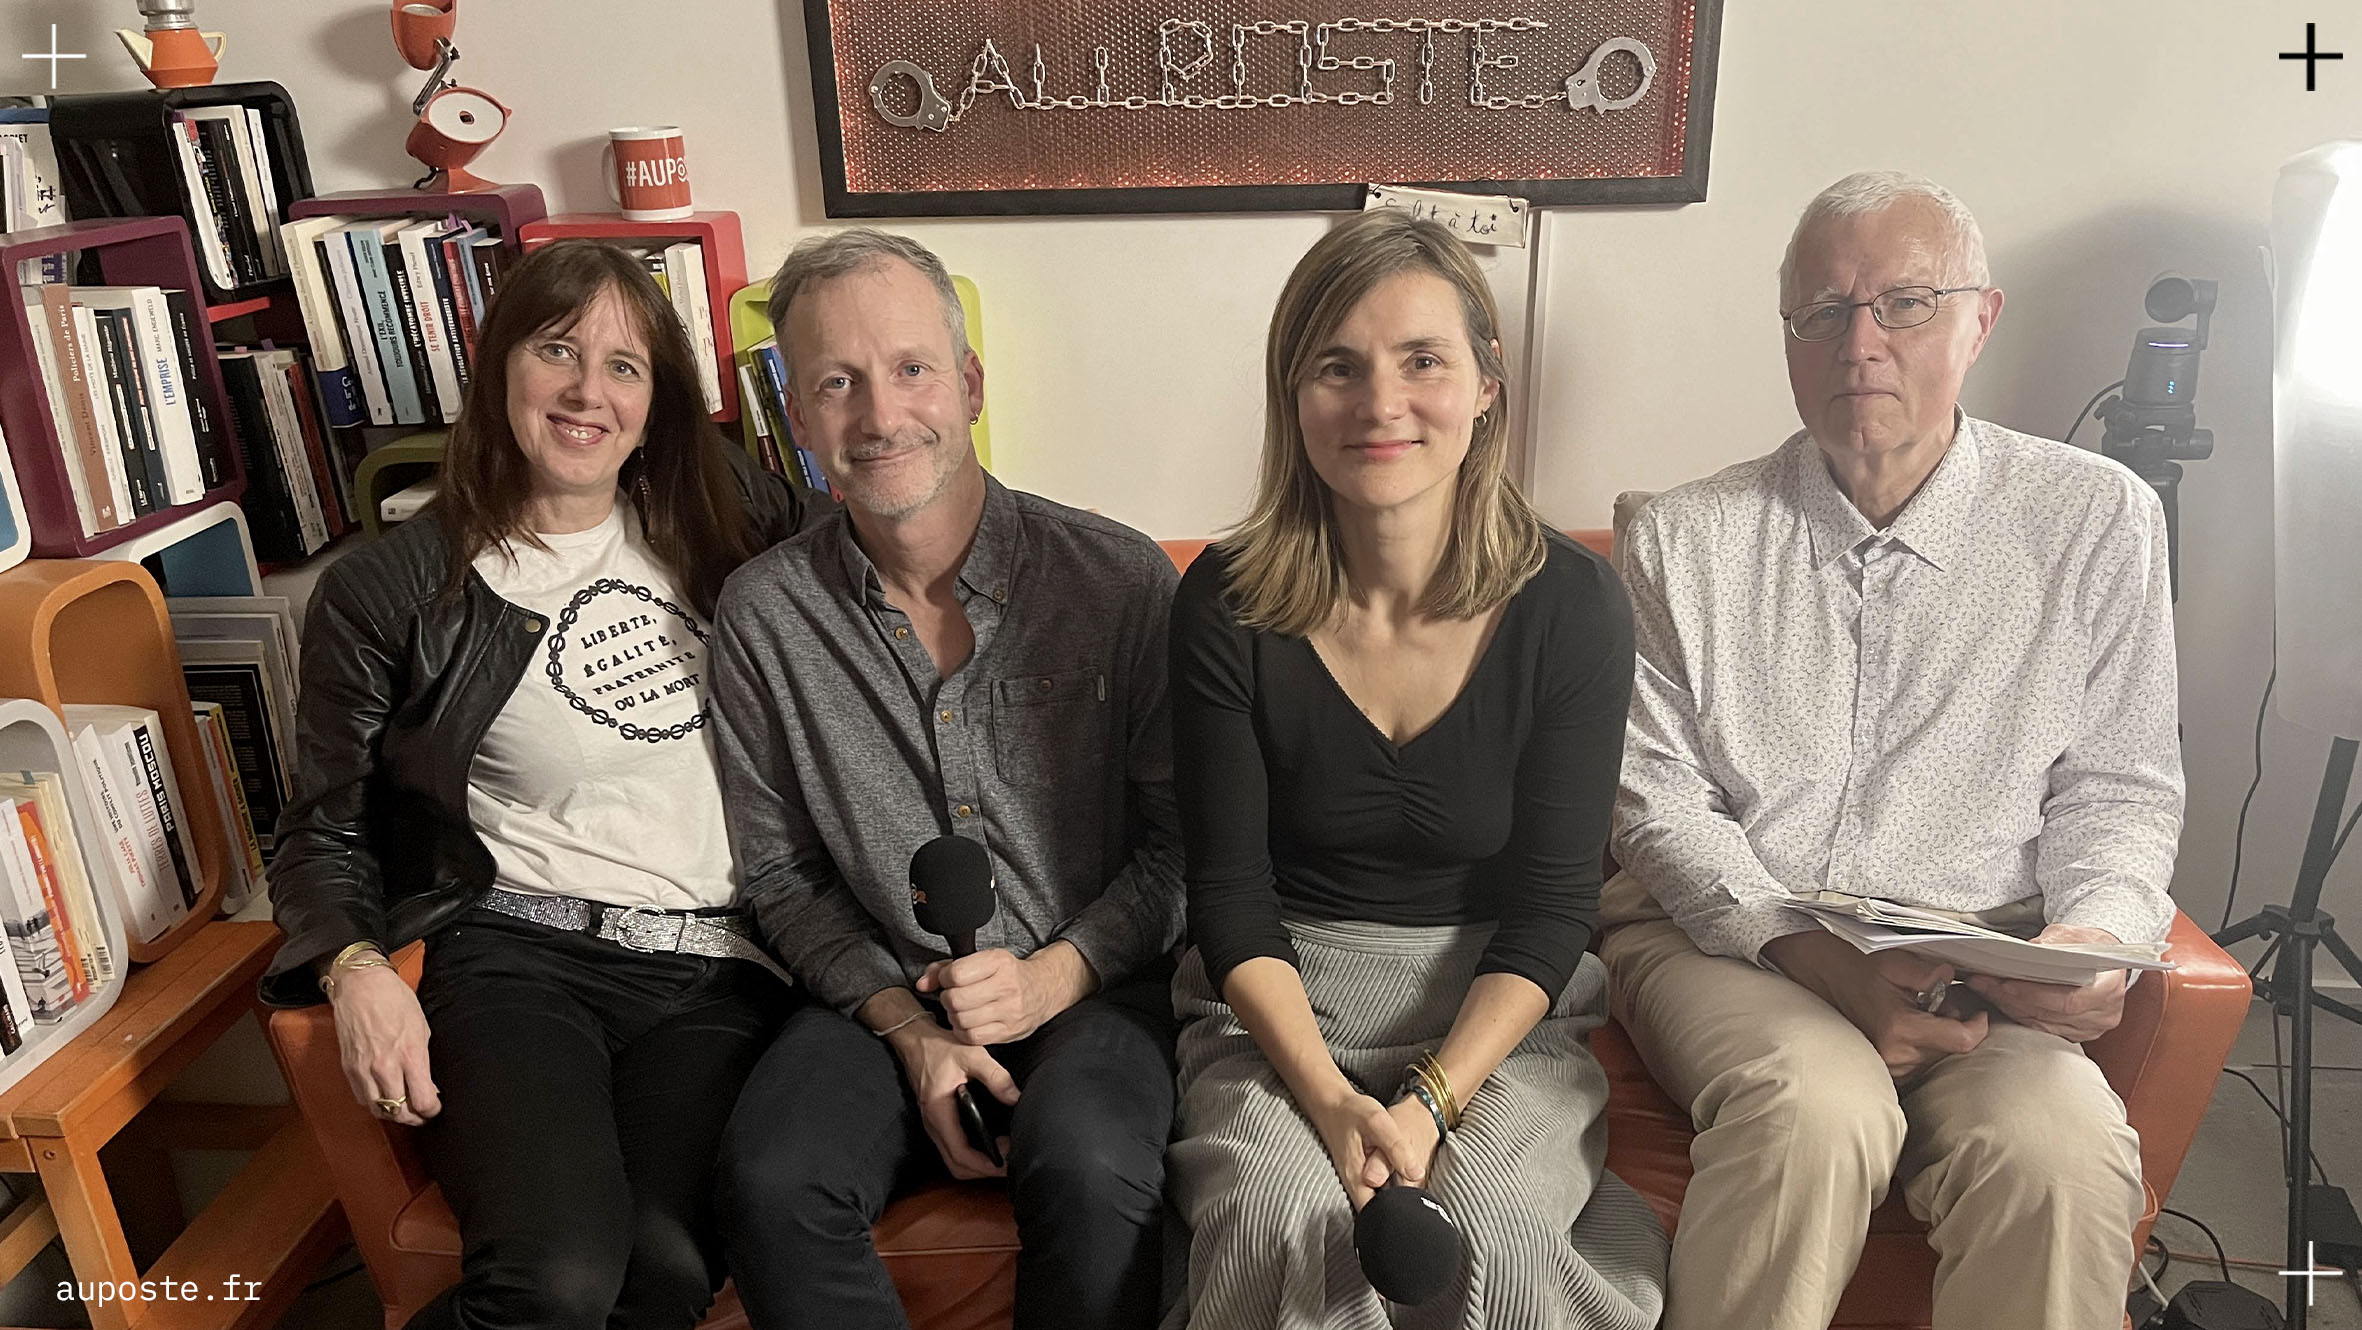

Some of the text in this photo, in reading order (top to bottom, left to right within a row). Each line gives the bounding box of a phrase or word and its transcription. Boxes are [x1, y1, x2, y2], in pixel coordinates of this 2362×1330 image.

[1448, 212, 1461, 229] à
[1467, 209, 1498, 235] toi
[60, 304, 81, 382] Policiers de Paris
[419, 301, 441, 352] SE TENIR DROIT
[160, 358, 176, 406] L'EMPRISE
[615, 674, 699, 711] OU LA MORT
[92, 758, 109, 794] POLITIQUE
[138, 733, 174, 831] PARIS MOSCOU
[136, 789, 170, 872] TERRES DE LUTTES
